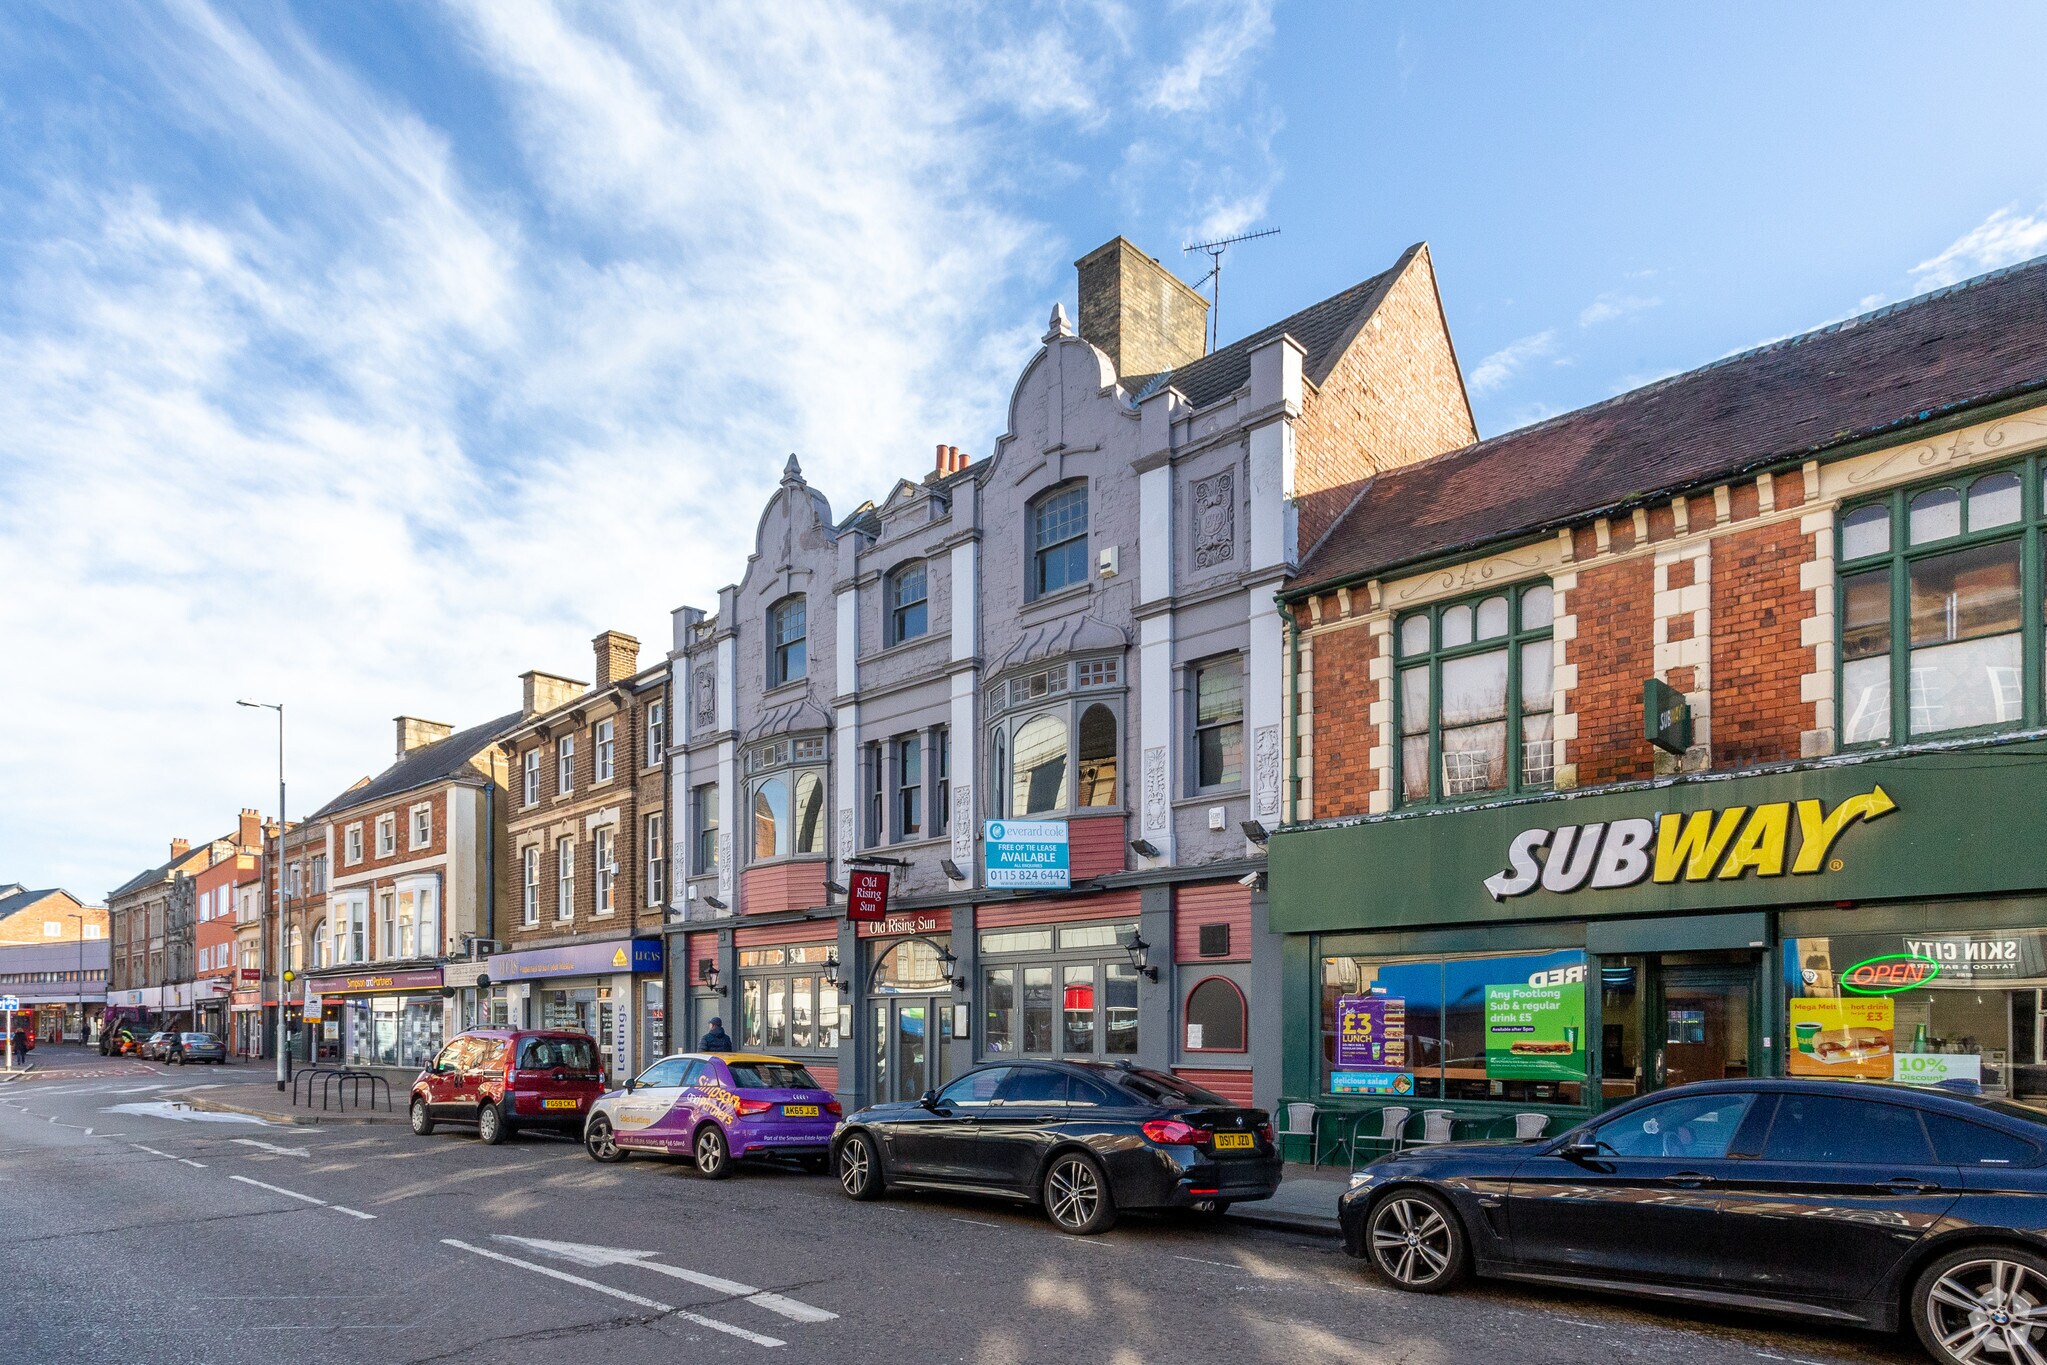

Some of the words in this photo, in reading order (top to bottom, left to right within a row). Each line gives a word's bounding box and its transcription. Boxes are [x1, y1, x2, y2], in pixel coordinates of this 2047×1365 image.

[1007, 825, 1042, 837] everard
[1045, 825, 1064, 837] cole
[1483, 783, 1896, 901] SUBWAY
[1000, 852, 1056, 863] AVAILABLE
[990, 870, 1016, 880] 0115
[1019, 870, 1038, 880] 824
[1041, 870, 1066, 880] 6442
[862, 876, 877, 887] Old
[856, 888, 881, 901] Rising
[860, 901, 876, 912] Sun
[870, 920, 886, 934] Old
[888, 918, 916, 934] Rising
[918, 916, 936, 930] Sun
[635, 950, 660, 961] LUCAS
[1853, 962, 1927, 985] OPEN
[347, 978, 365, 990] Simpson
[373, 976, 394, 986] Partners
[1490, 990, 1511, 1000] Any
[1513, 989, 1561, 999] Footlong
[1490, 1002, 1510, 1011] Sub
[1512, 1002, 1520, 1010] &
[1523, 1001, 1560, 1011] regular
[1490, 1013, 1516, 1022] drink
[1519, 1013, 1532, 1022] £5
[1867, 1012, 1883, 1021] £3
[1343, 1013, 1372, 1035] £3
[616, 1004, 628, 1072] Lettings
[1343, 1035, 1372, 1043] LUNCH
[1898, 1058, 1948, 1072] 10%
[1333, 1076, 1365, 1084] delicious
[1367, 1077, 1388, 1085] salad
[1900, 1073, 1944, 1081] Discount
[694, 1075, 742, 1108] Simpson
[699, 1096, 734, 1125] Partners
[785, 1106, 803, 1115] AK65
[805, 1106, 818, 1115] JJE
[1219, 1135, 1235, 1146] DS17
